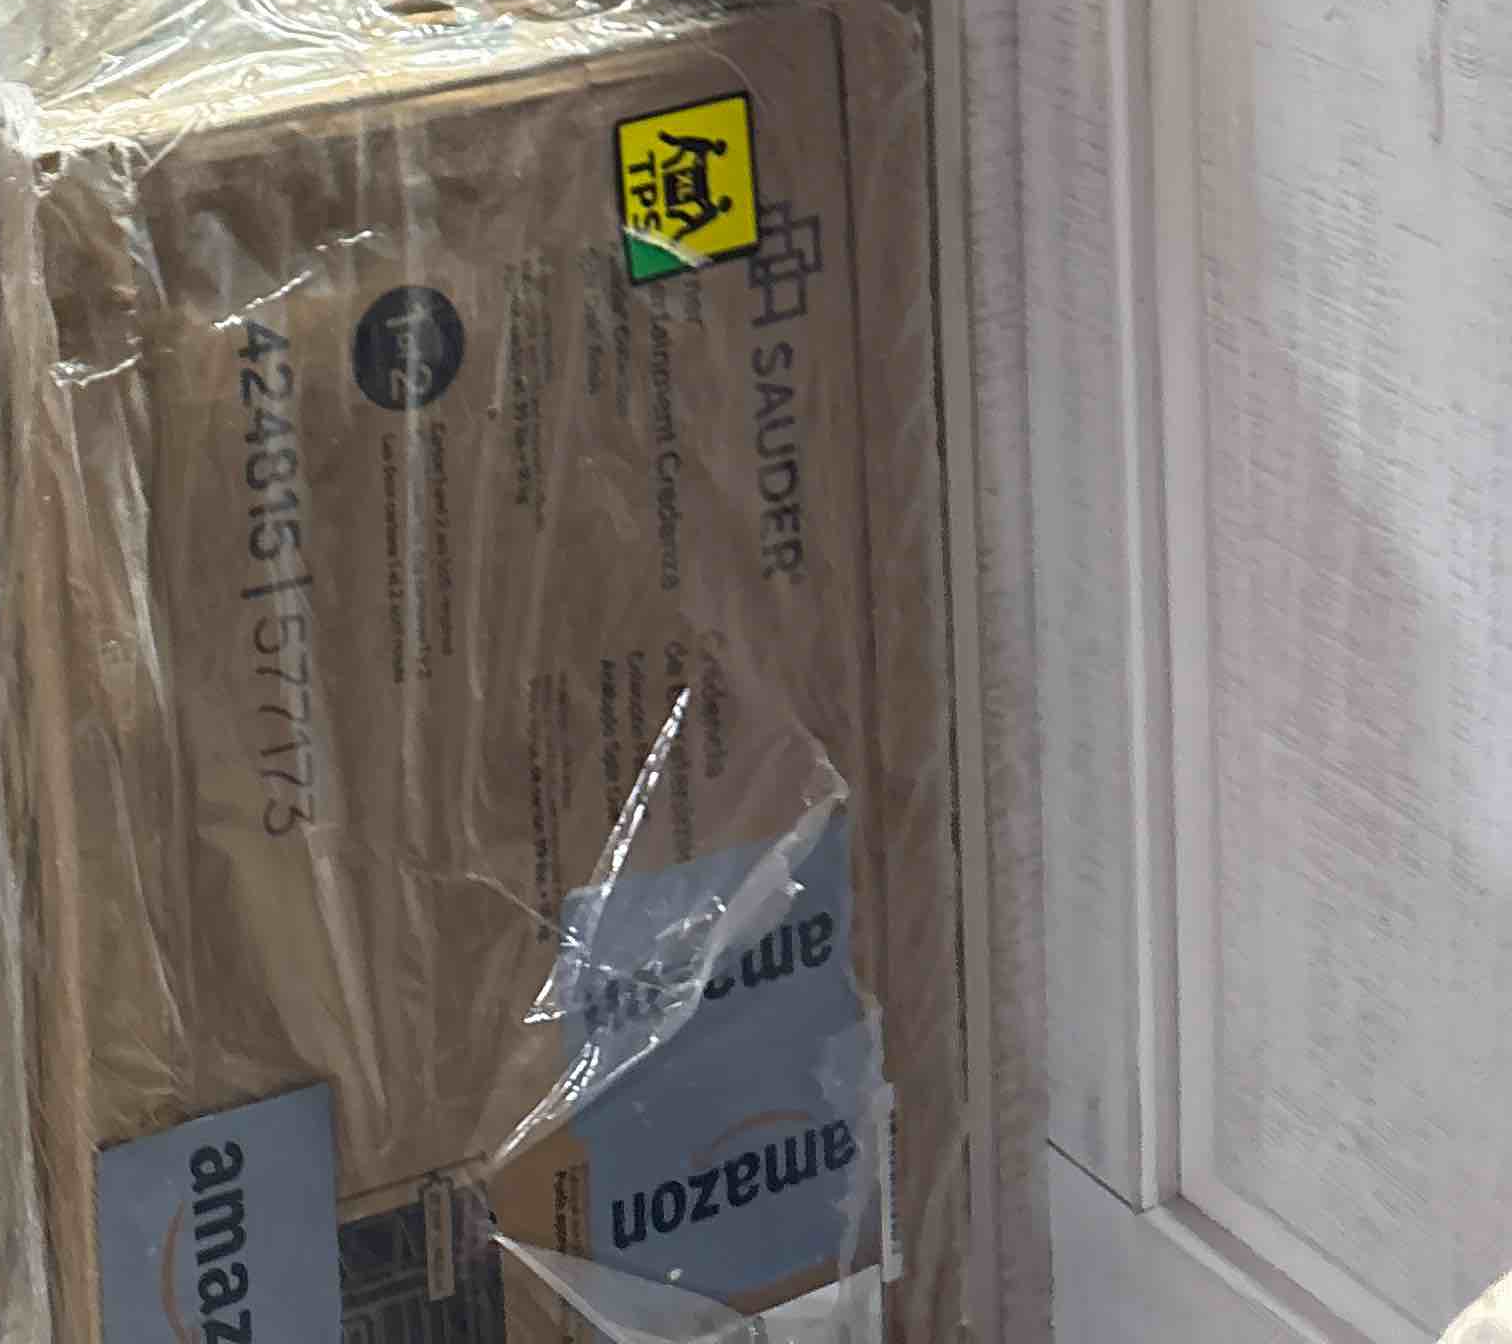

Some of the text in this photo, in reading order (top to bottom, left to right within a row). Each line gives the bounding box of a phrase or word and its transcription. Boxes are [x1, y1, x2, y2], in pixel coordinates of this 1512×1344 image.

[628, 150, 662, 235] TPS
[239, 319, 302, 561] 424815
[390, 365, 434, 402] 2
[751, 342, 803, 582] SAUDER
[251, 614, 316, 837] 577173
[610, 1118, 858, 1249] amazon
